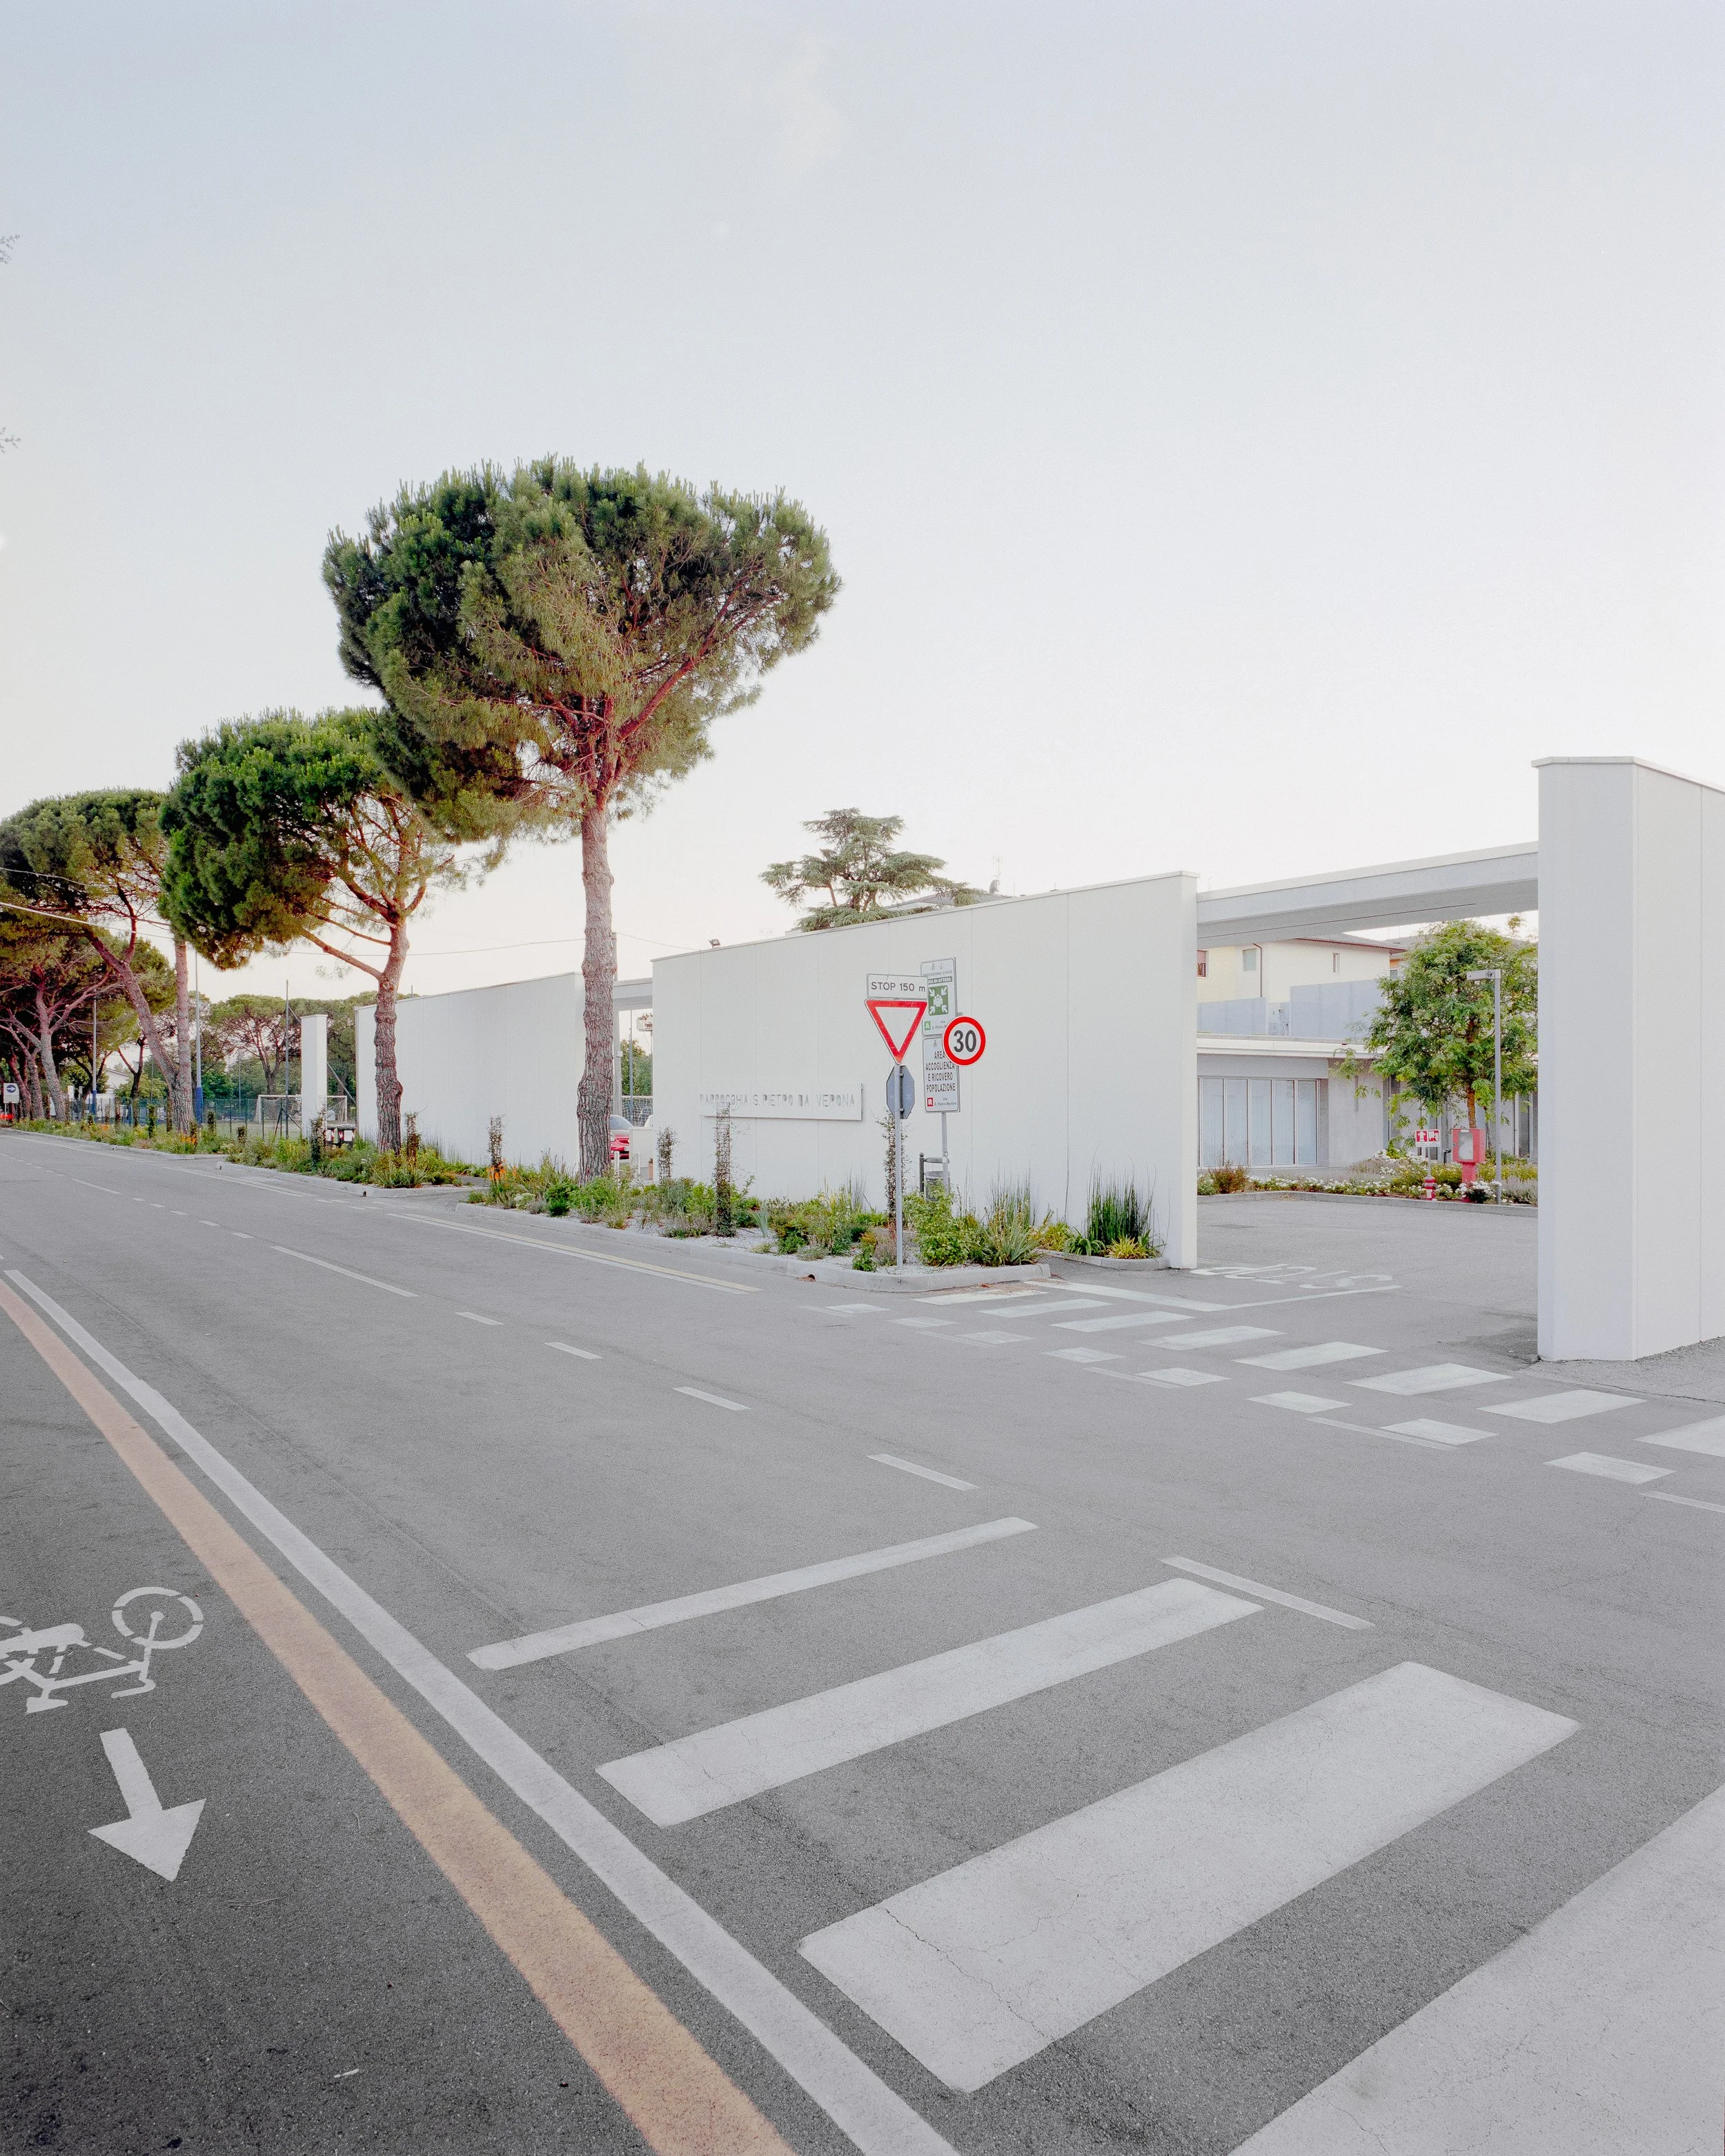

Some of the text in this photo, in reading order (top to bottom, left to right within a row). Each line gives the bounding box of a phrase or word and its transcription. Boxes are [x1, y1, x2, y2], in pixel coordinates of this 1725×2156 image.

[871, 981, 896, 991] STOP
[900, 982, 915, 991] 150
[954, 1029, 976, 1053] 30
[934, 1051, 945, 1059] AREA
[925, 1061, 955, 1071] ACCOGLIENZA
[928, 1072, 953, 1082] E RICOVERO
[927, 1083, 955, 1092] POPOLAZIONE
[753, 1094, 760, 1106] S.
[762, 1094, 793, 1107] PIETRO
[798, 1094, 810, 1107] DA
[816, 1094, 856, 1107] VERONA
